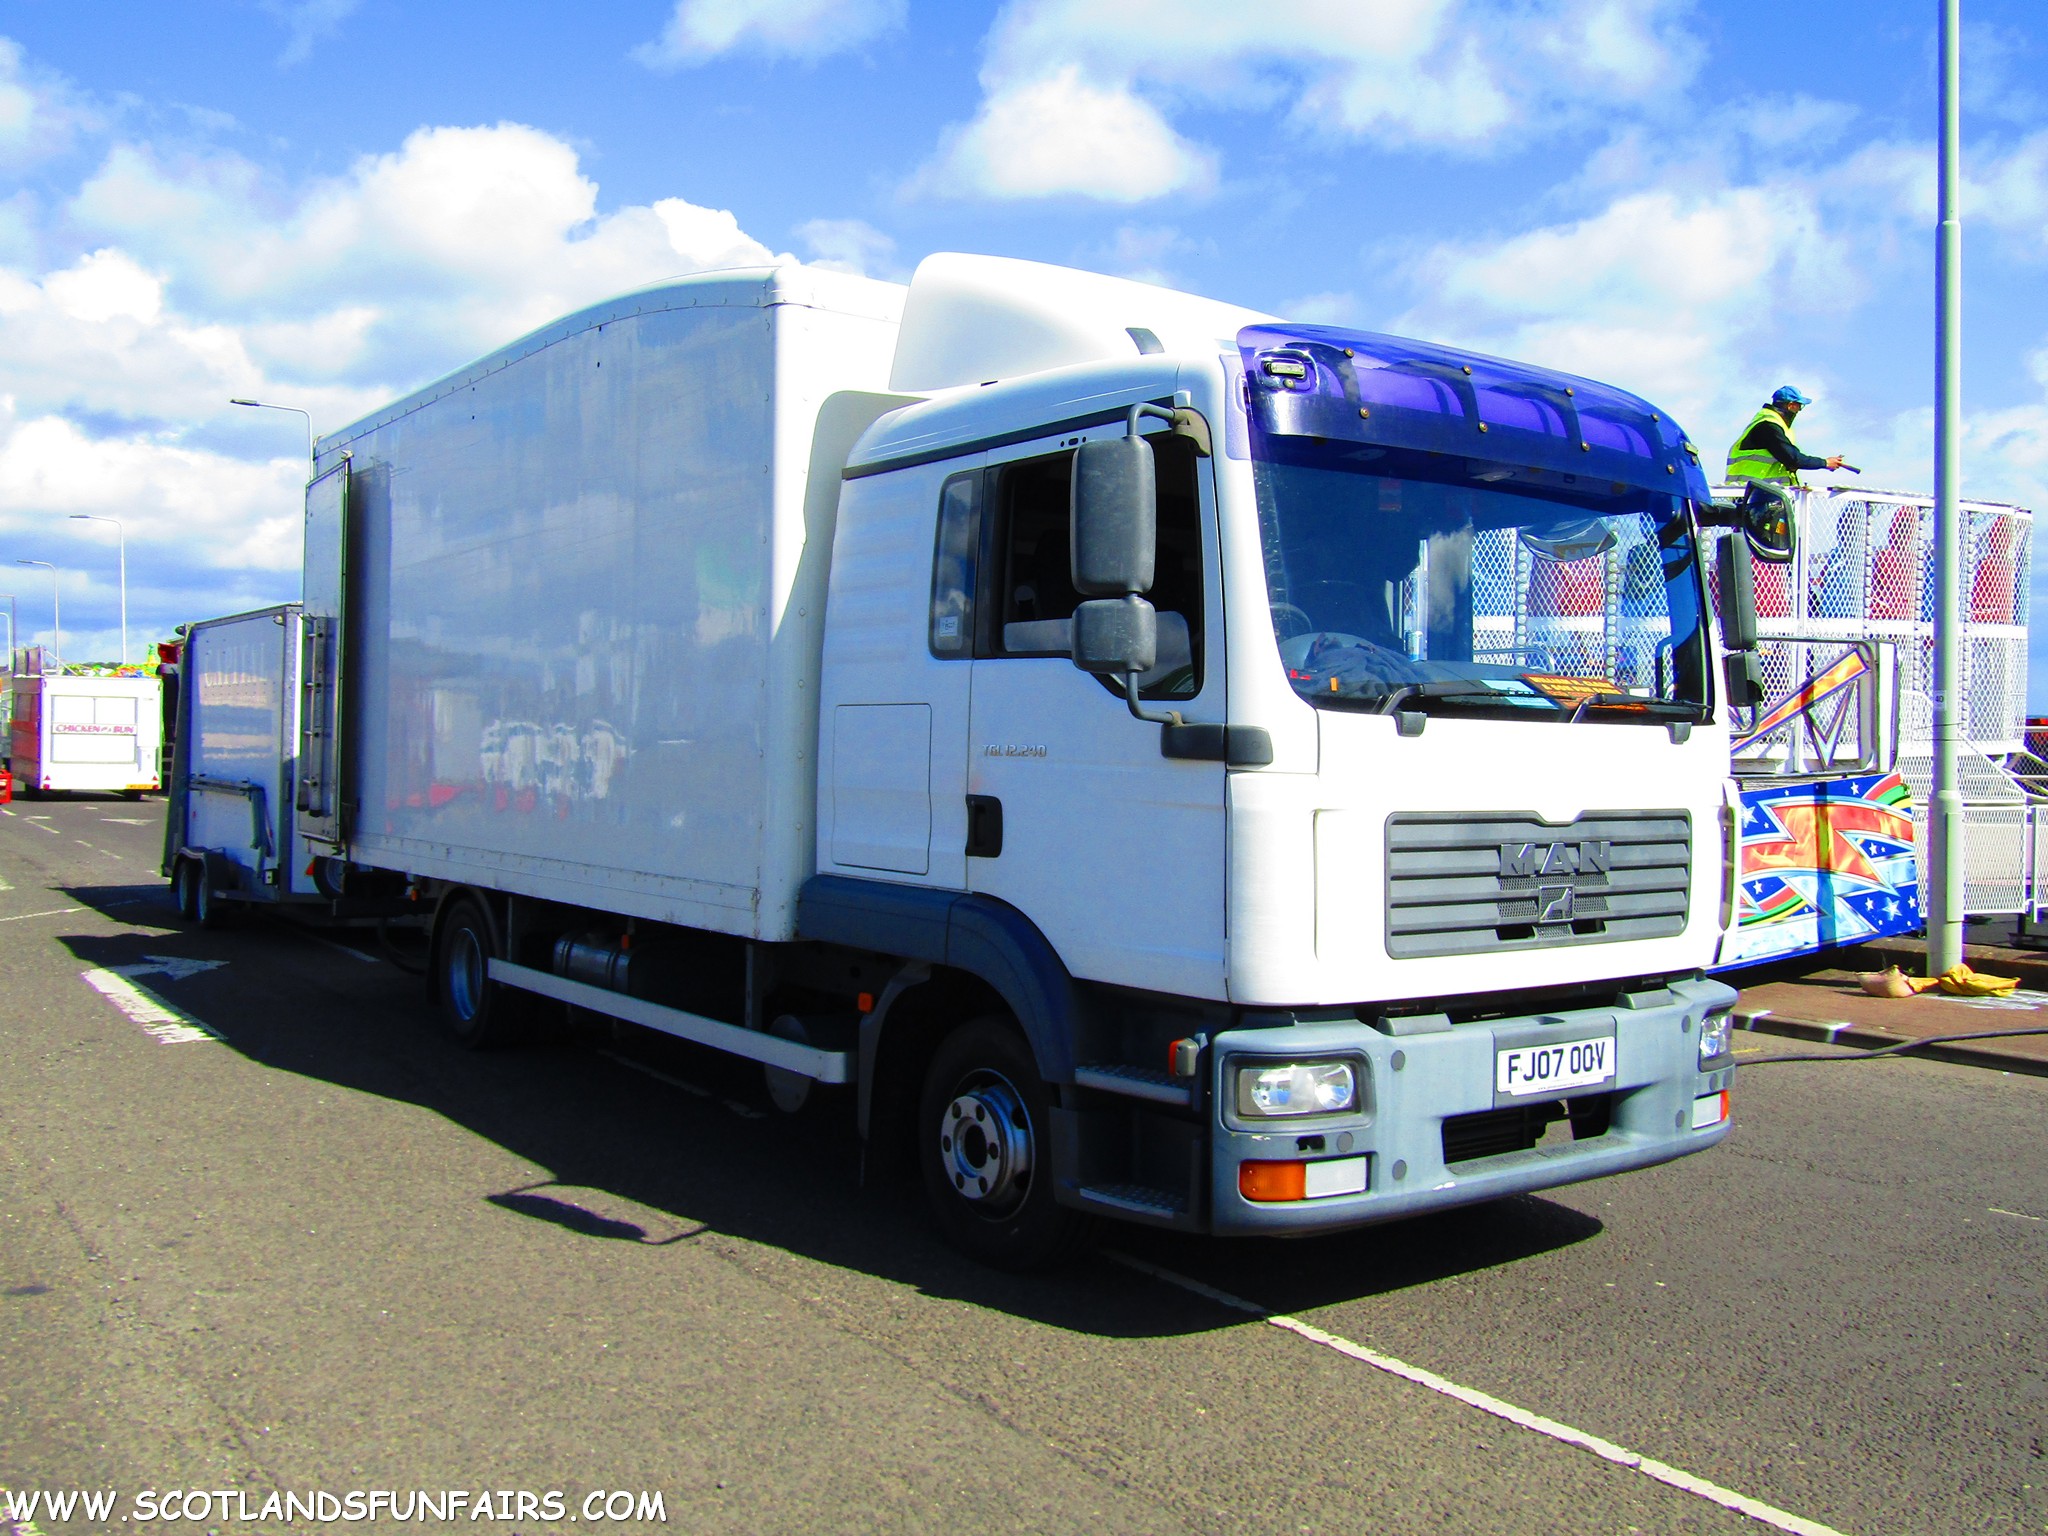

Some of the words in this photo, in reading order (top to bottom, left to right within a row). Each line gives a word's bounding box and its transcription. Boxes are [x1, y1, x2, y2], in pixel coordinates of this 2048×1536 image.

[55, 723, 100, 733] CHICKEN
[983, 744, 1003, 757] TGL
[1500, 841, 1610, 876] MAN
[1508, 1047, 1565, 1084] FJ07
